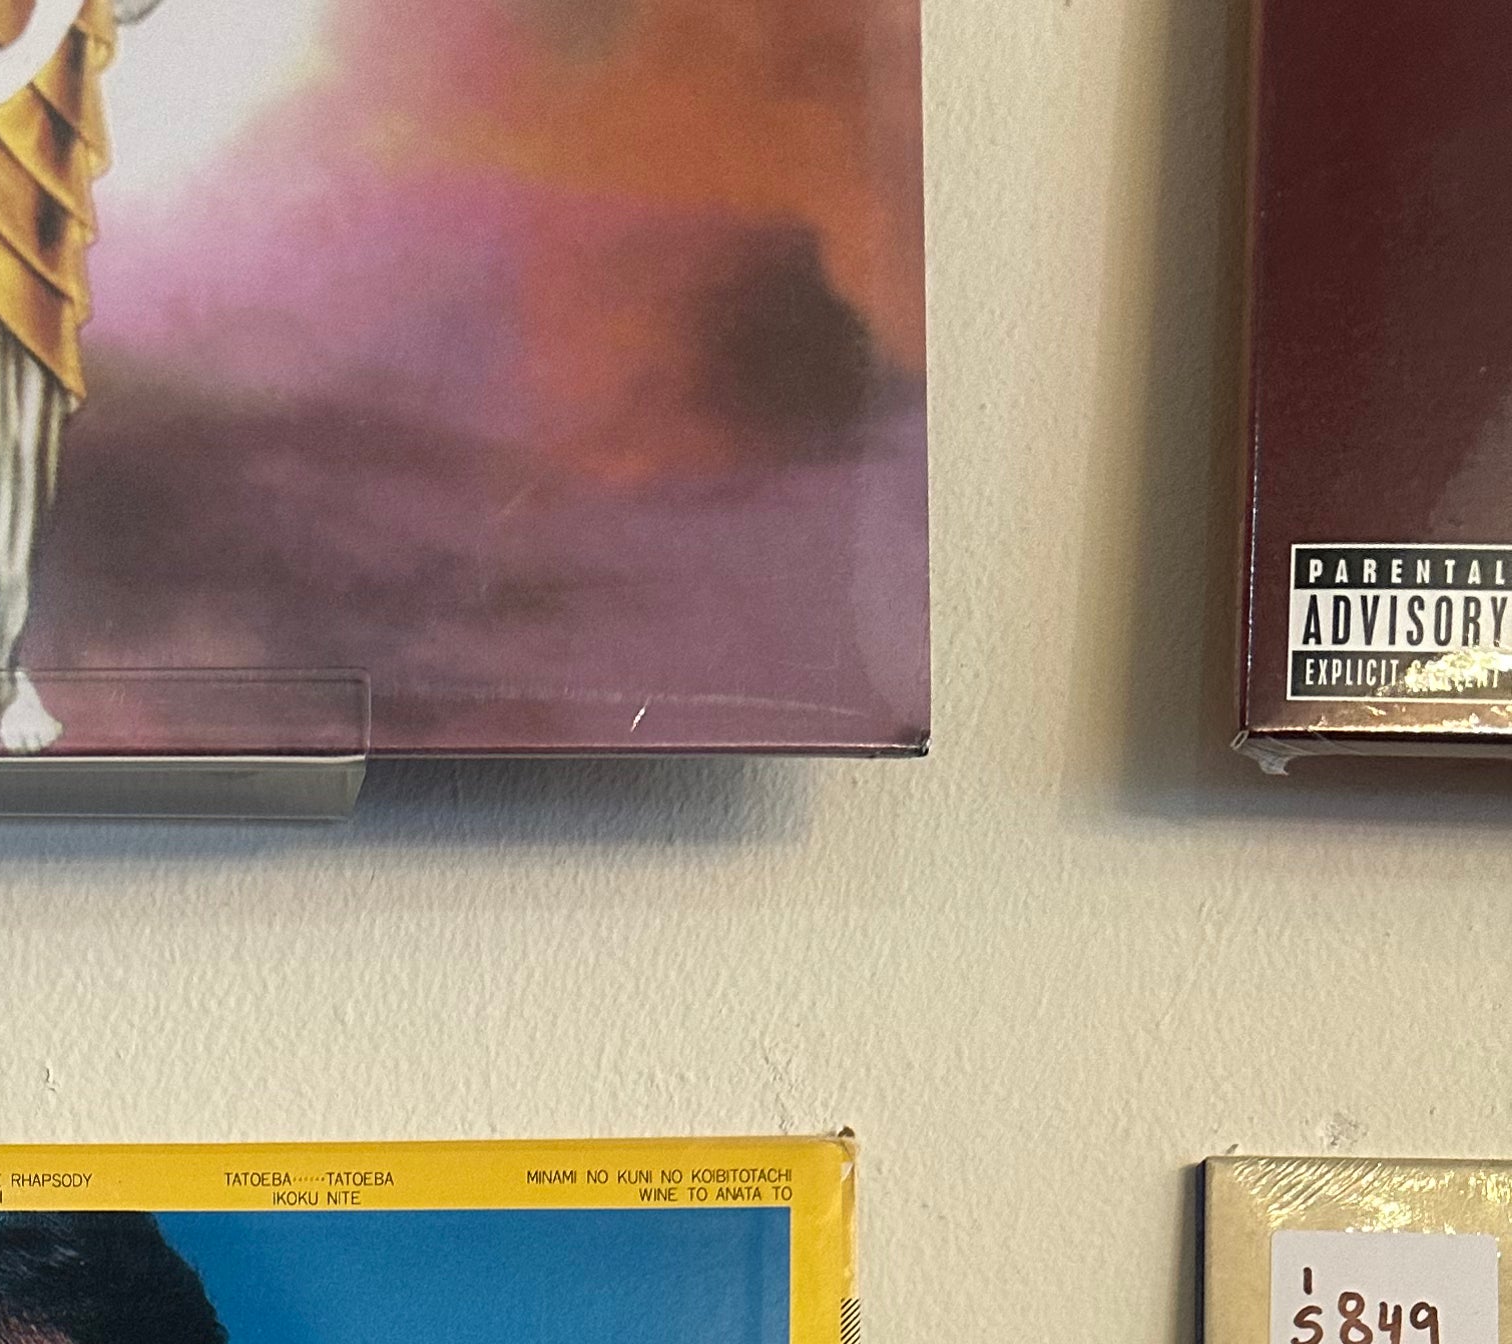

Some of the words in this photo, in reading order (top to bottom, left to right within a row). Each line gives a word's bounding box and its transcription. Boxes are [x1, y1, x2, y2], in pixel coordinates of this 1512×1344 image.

[1308, 558, 1506, 586] PARENTAL
[1301, 594, 1508, 647] ADVISORY
[1304, 658, 1400, 686] EXPLICIT
[11, 1172, 93, 1188] RHAPSODY
[526, 1169, 577, 1185] MINAMI
[586, 1169, 609, 1184] NO
[617, 1169, 653, 1185] KUNI
[660, 1168, 683, 1184] NO
[691, 1167, 792, 1184] KOIBITOTACHI
[272, 1190, 319, 1206] IKOKU
[327, 1190, 361, 1206] NITE
[638, 1186, 678, 1202] WINE
[687, 1186, 709, 1202] TO
[715, 1186, 762, 1201] ANATA
[771, 1185, 793, 1202] TO
